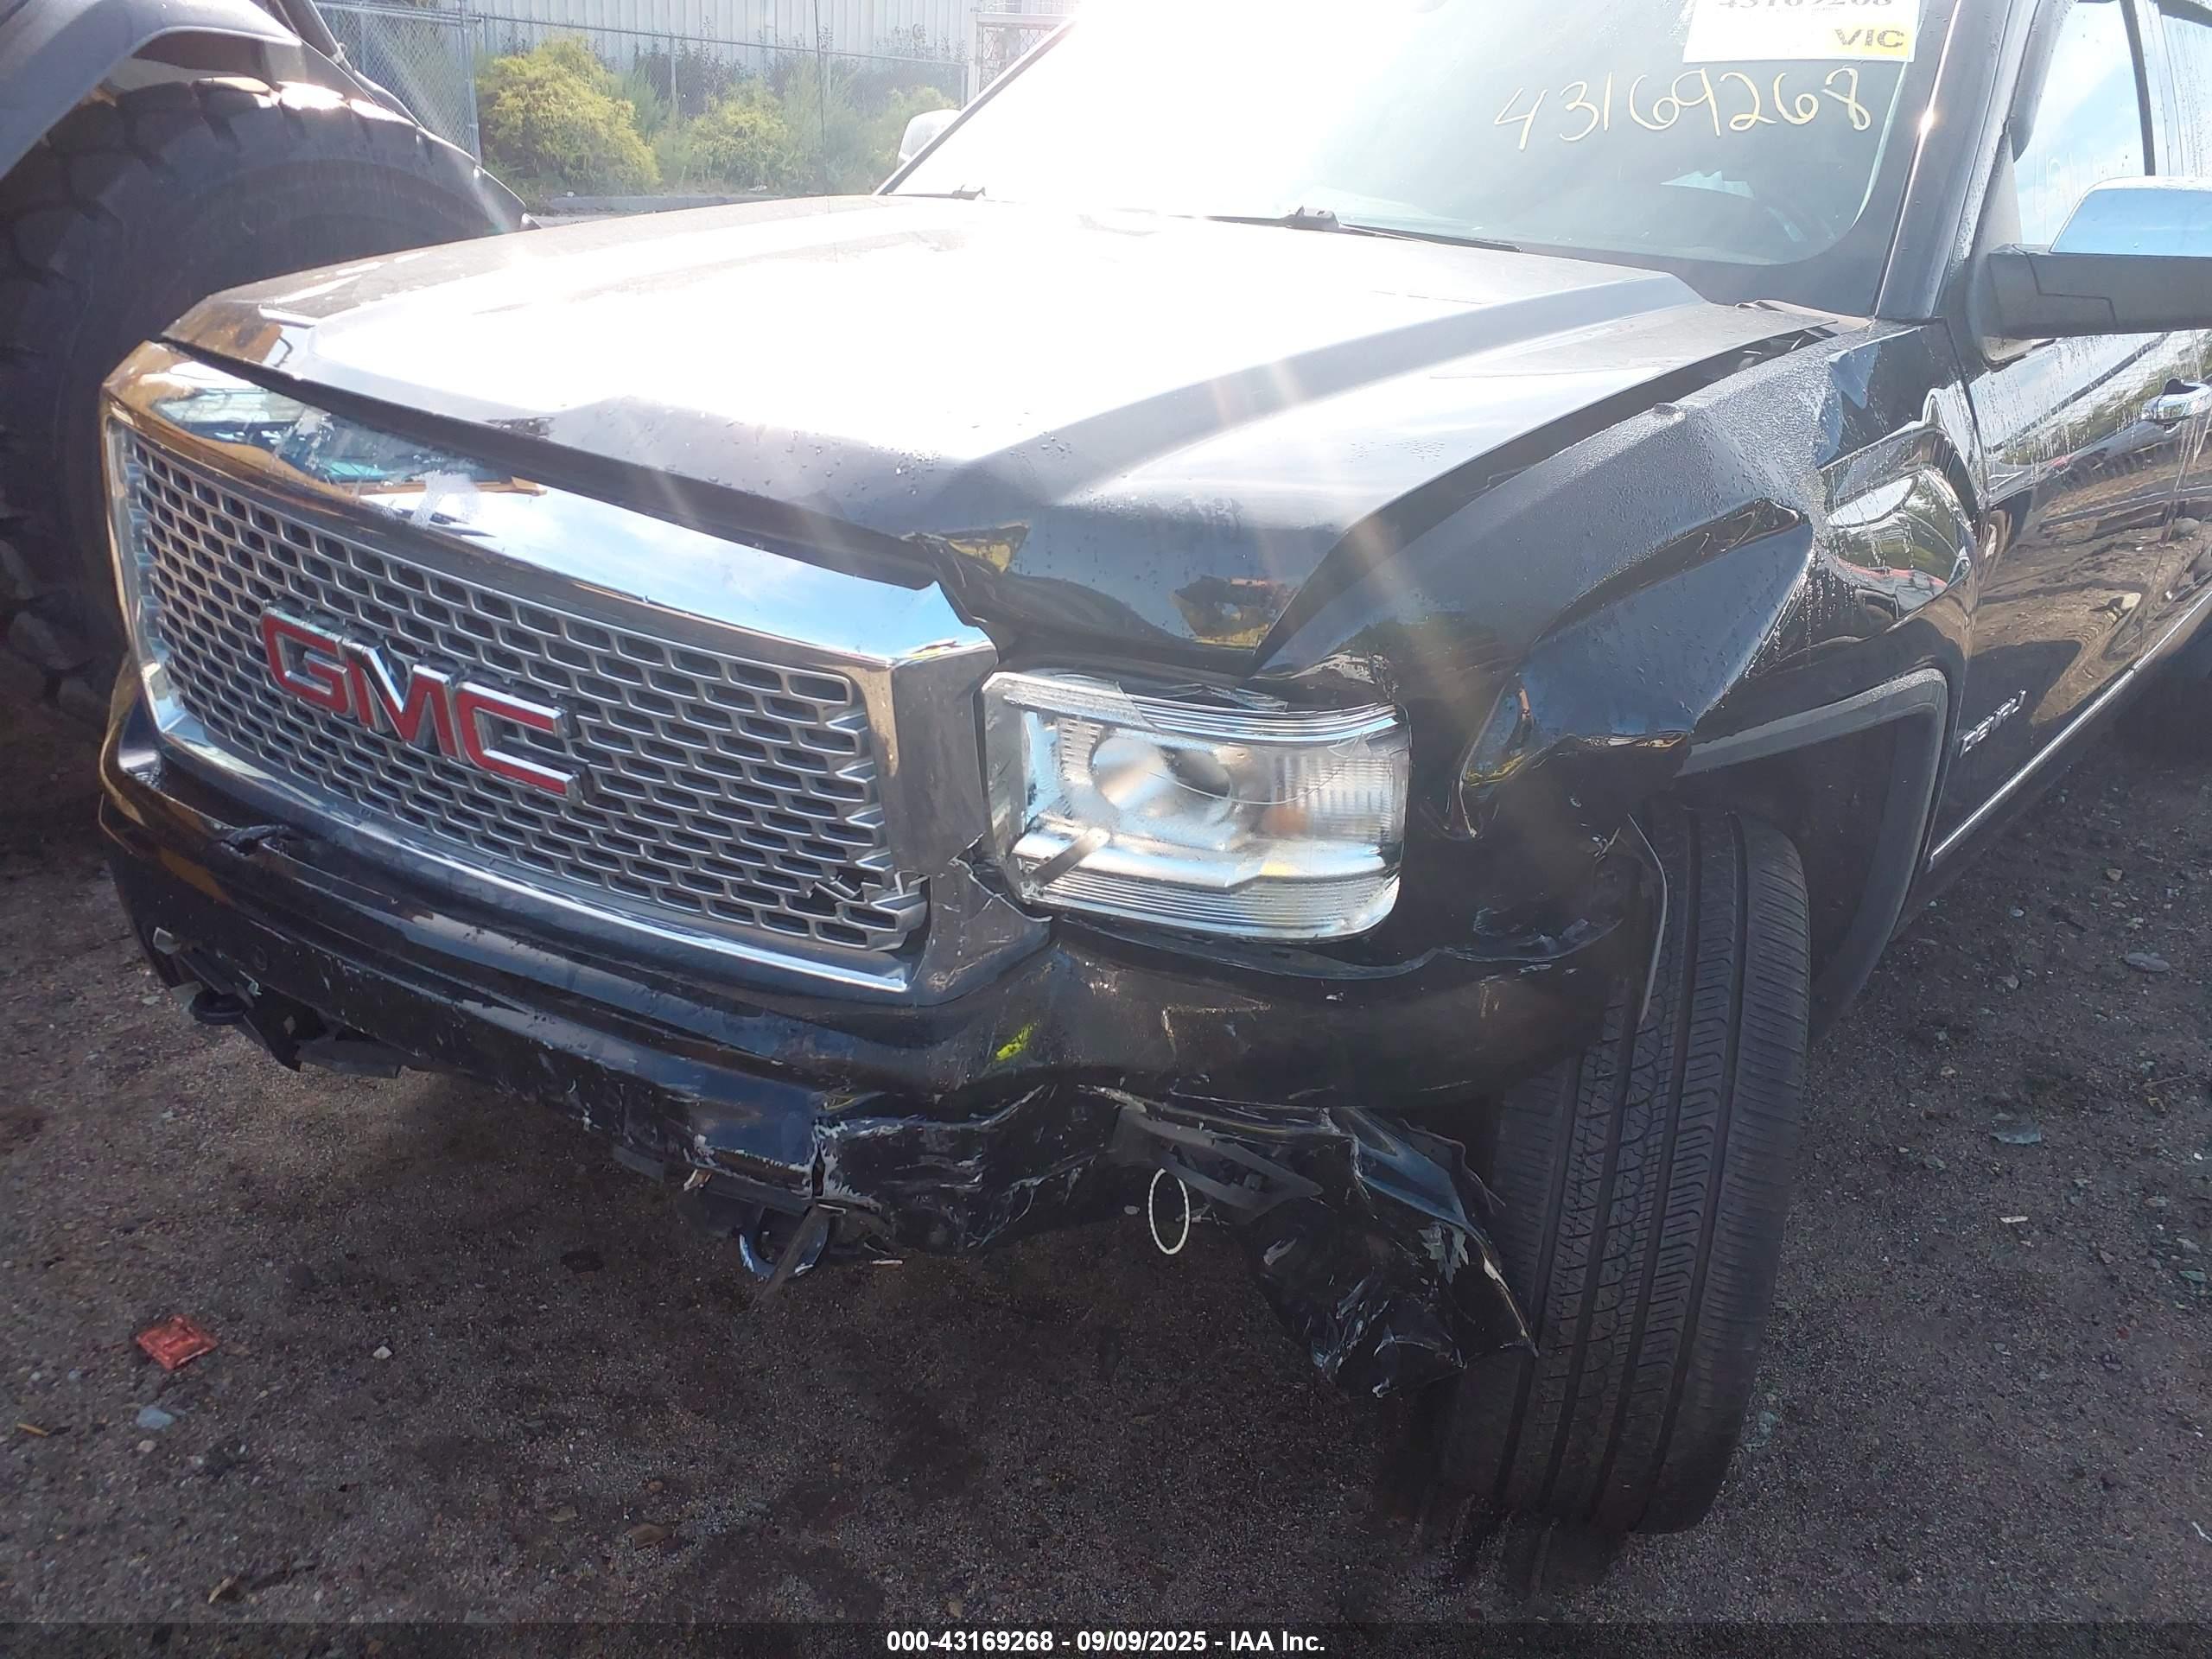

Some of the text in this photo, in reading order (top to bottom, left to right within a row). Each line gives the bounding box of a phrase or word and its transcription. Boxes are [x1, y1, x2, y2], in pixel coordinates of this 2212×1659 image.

[1834, 29, 1904, 48] VIC
[1494, 68, 1872, 150] 43169268
[263, 607, 580, 803] GMC
